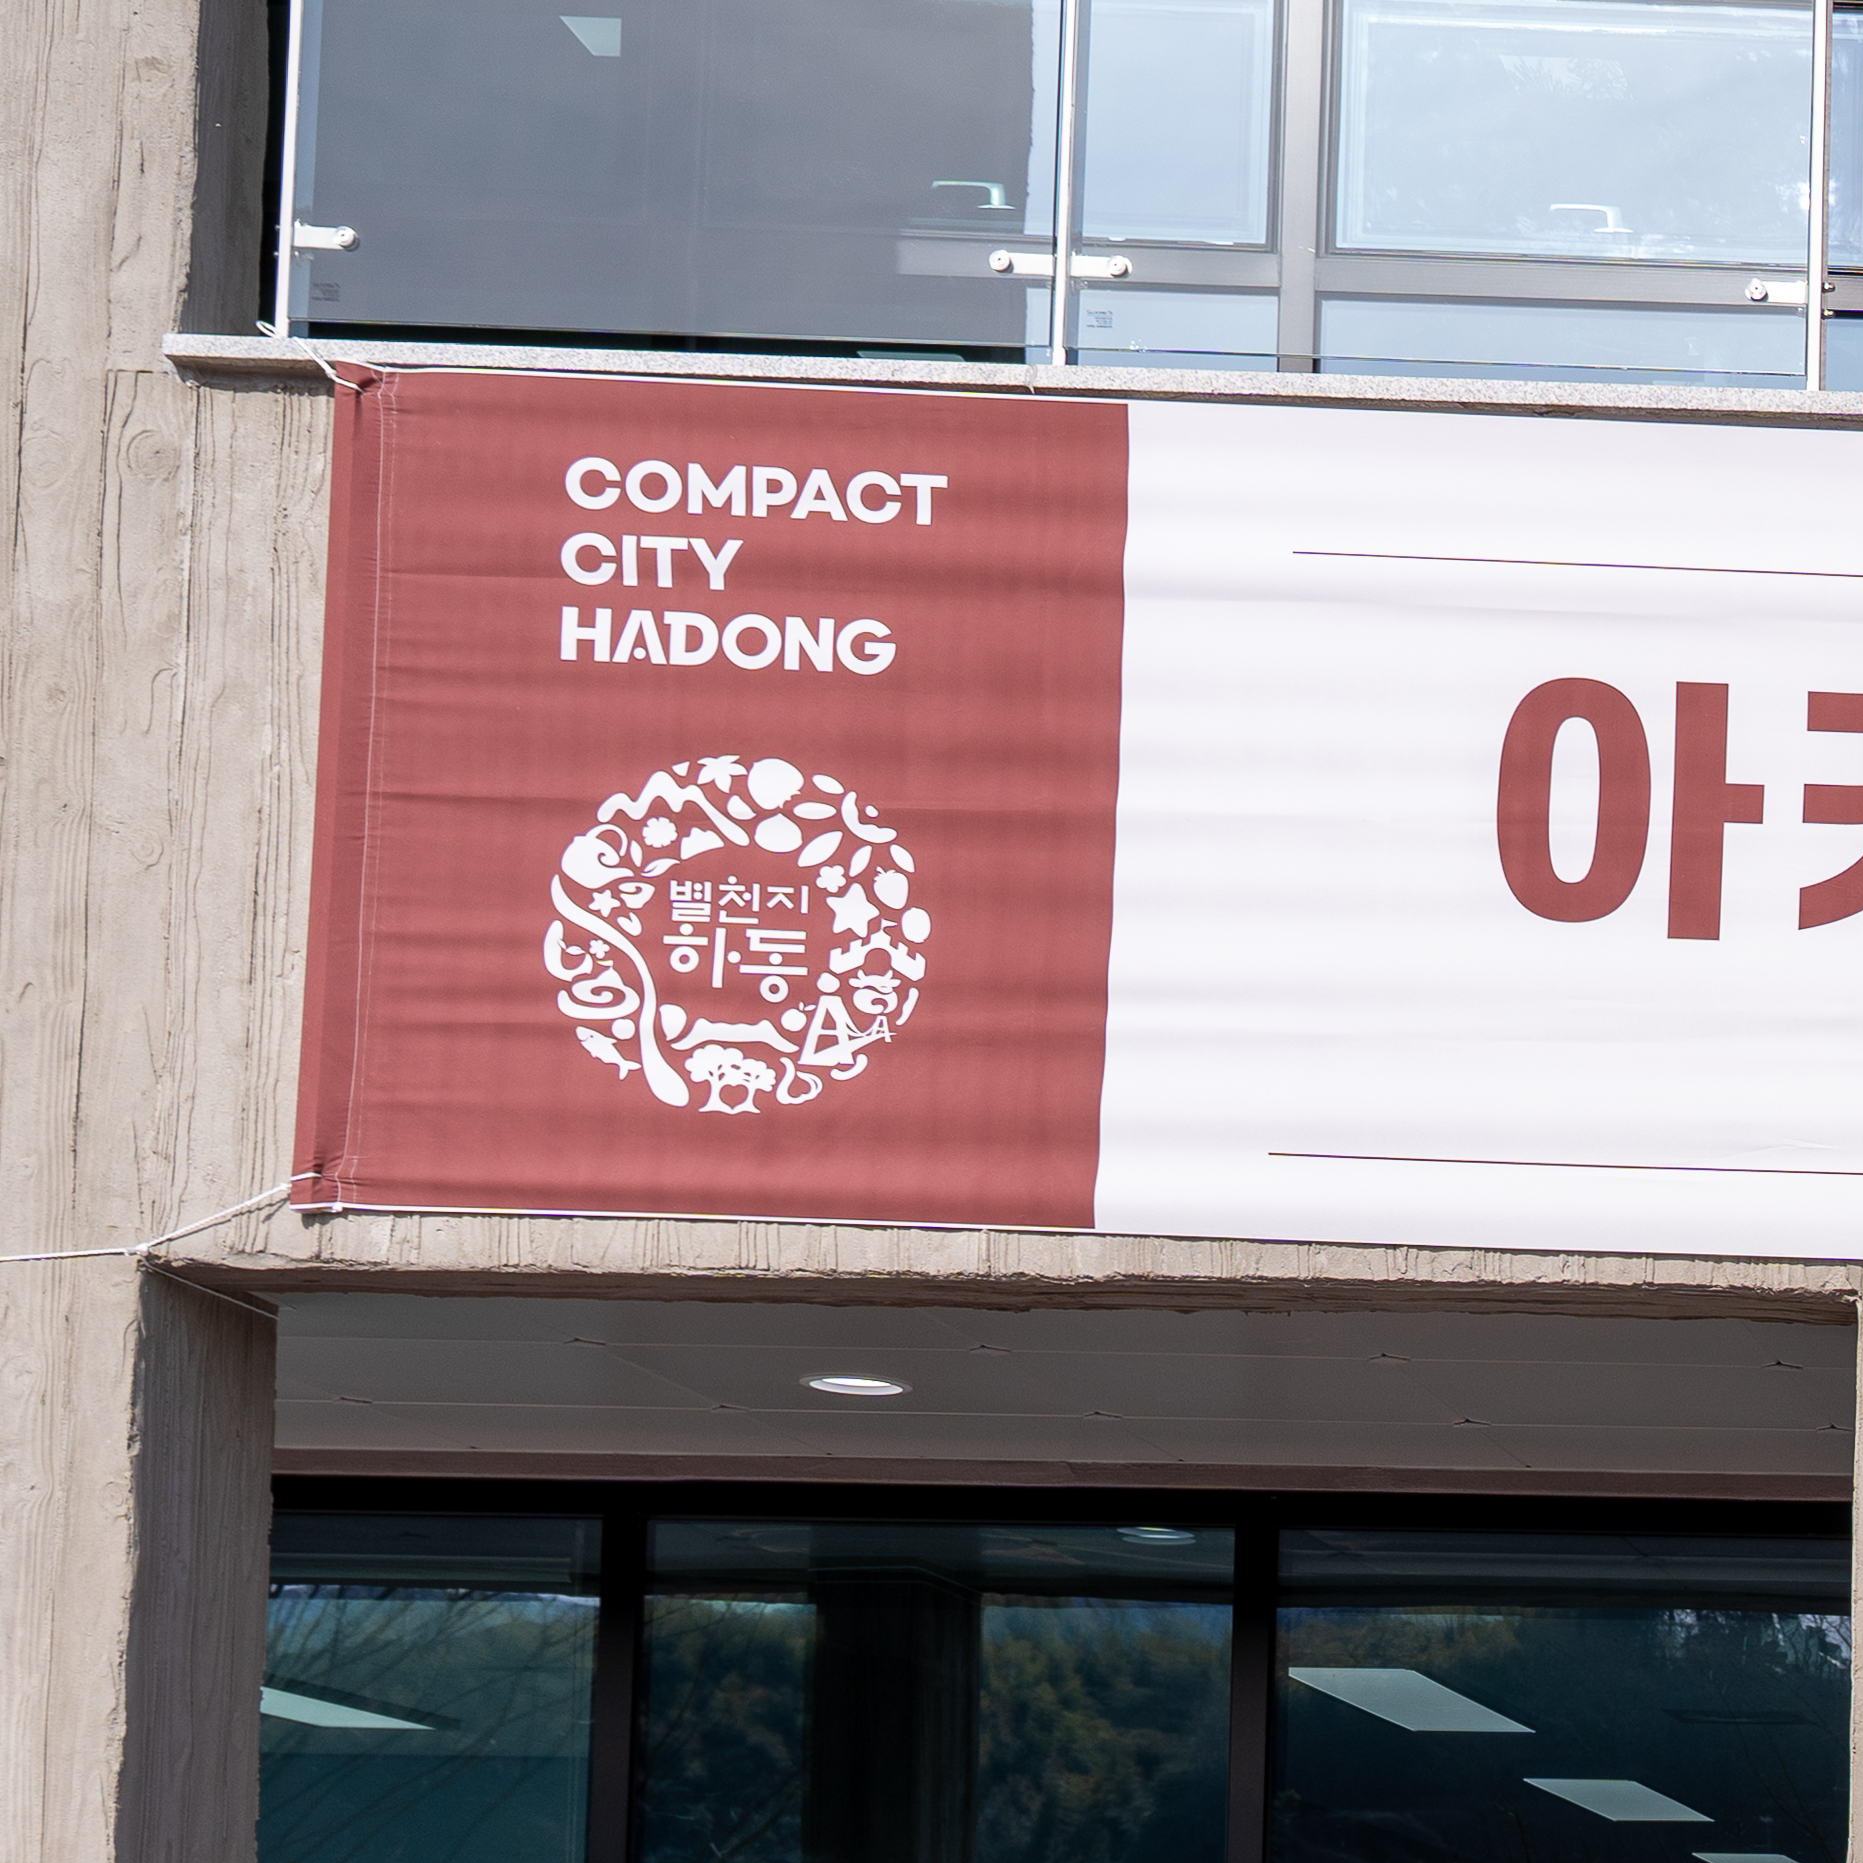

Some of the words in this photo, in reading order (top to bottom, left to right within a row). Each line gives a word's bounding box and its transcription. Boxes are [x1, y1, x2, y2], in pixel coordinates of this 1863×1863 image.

[566, 456, 947, 525] COMPACT
[560, 532, 743, 590] CITY
[560, 606, 896, 675] HADONG
[669, 875, 809, 925] 별천지
[663, 922, 808, 1003] 하동
